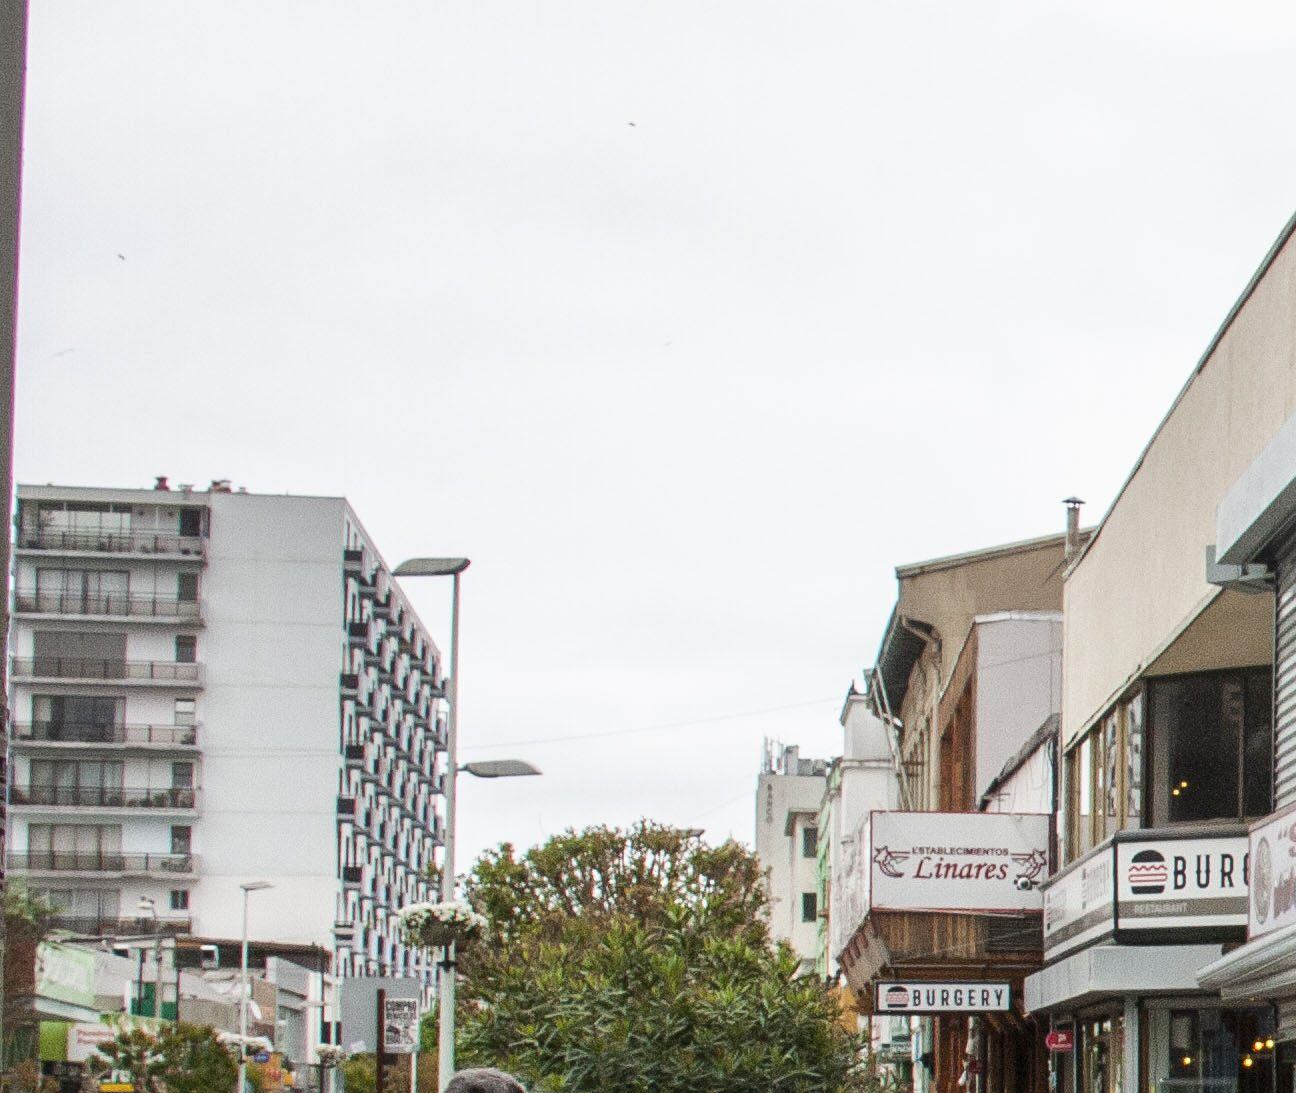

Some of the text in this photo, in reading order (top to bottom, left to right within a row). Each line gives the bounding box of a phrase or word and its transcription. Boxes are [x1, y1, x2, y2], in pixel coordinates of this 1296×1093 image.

[911, 846, 1008, 856] ESTABLECIMIENTOS
[912, 857, 1008, 880] Linares
[912, 989, 1004, 1007] BURGERY
